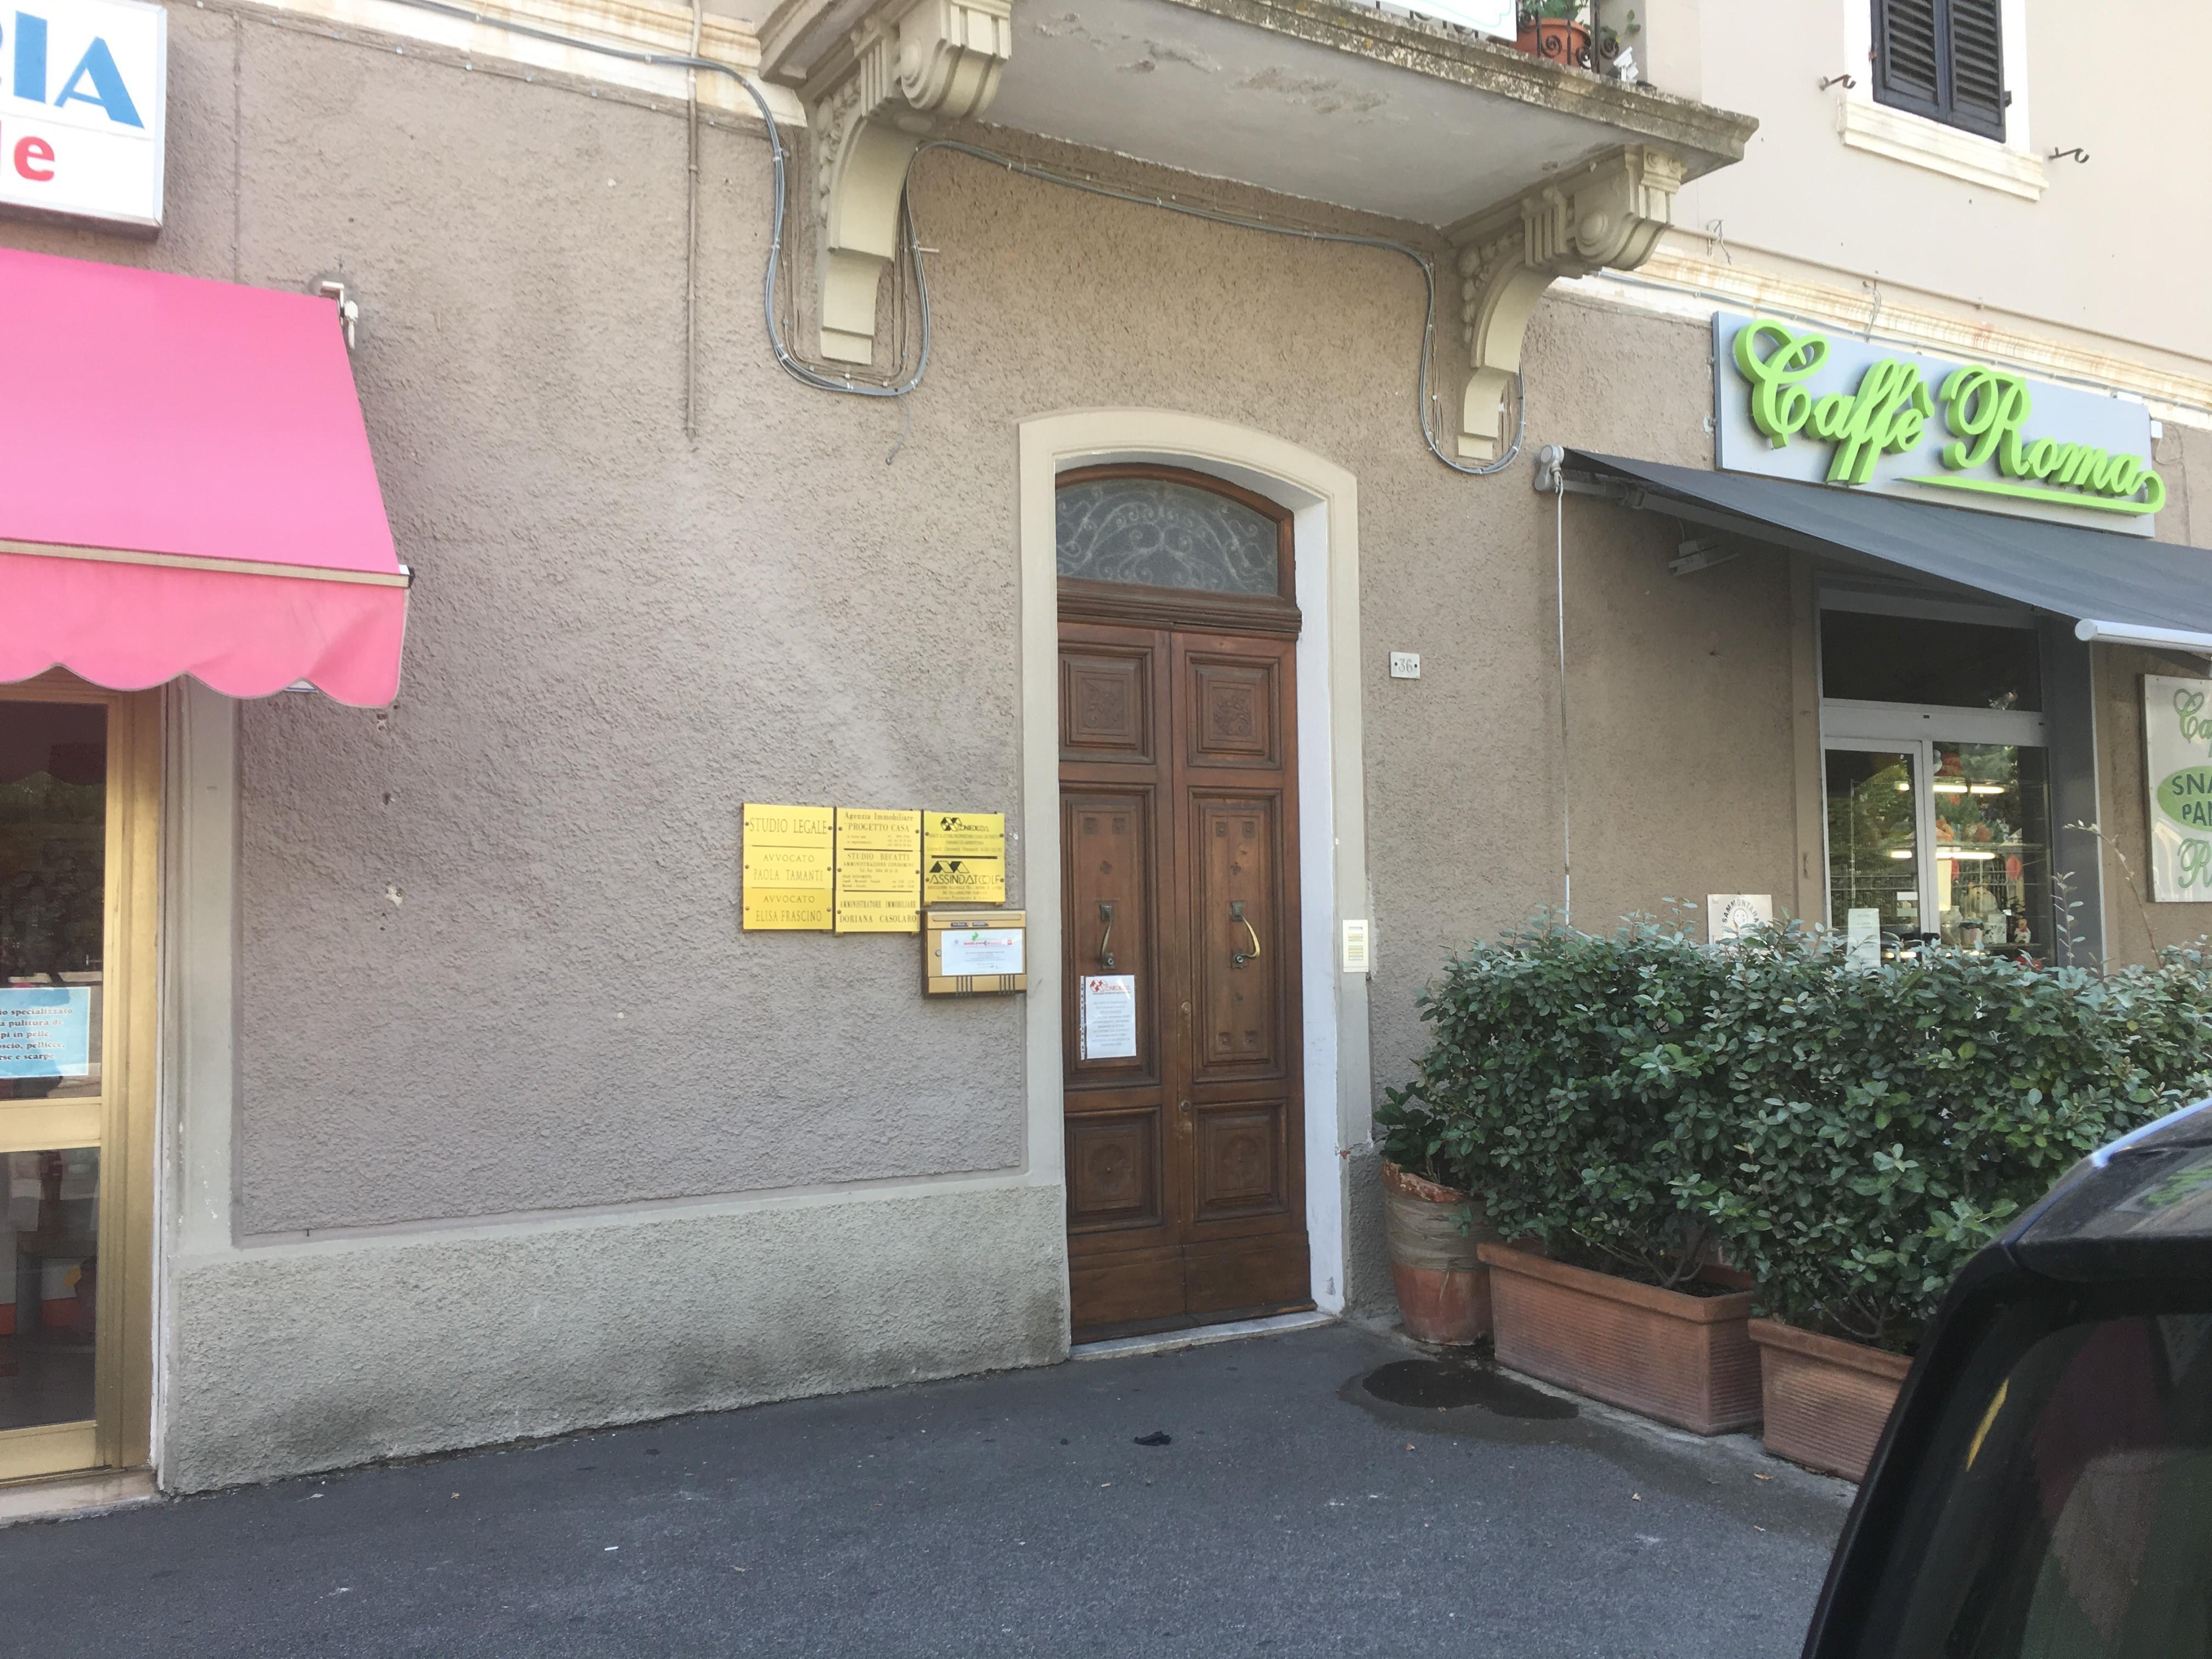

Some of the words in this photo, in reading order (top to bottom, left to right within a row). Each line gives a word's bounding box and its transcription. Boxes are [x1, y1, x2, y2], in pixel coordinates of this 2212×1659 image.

[0, 10, 145, 129] IA
[1939, 364, 2166, 510] Roma
[1398, 658, 1413, 673] 36
[2173, 688, 2212, 758] Ca
[845, 811, 871, 820] Agenzia
[874, 812, 913, 821] Immobiliare
[749, 817, 787, 832] STUDIO
[794, 820, 827, 834] LEGALE
[763, 854, 815, 862] AVVOCATO
[754, 869, 780, 880] PAOLA
[786, 870, 823, 881] TAMANTI
[885, 900, 916, 909] IMMOBILIARE
[1722, 898, 1759, 923] SAMMONTANA
[755, 910, 778, 922] ELISA
[781, 910, 822, 922] FRASCINO
[839, 915, 873, 923] DORIANA
[879, 915, 917, 923] CASOLARO
